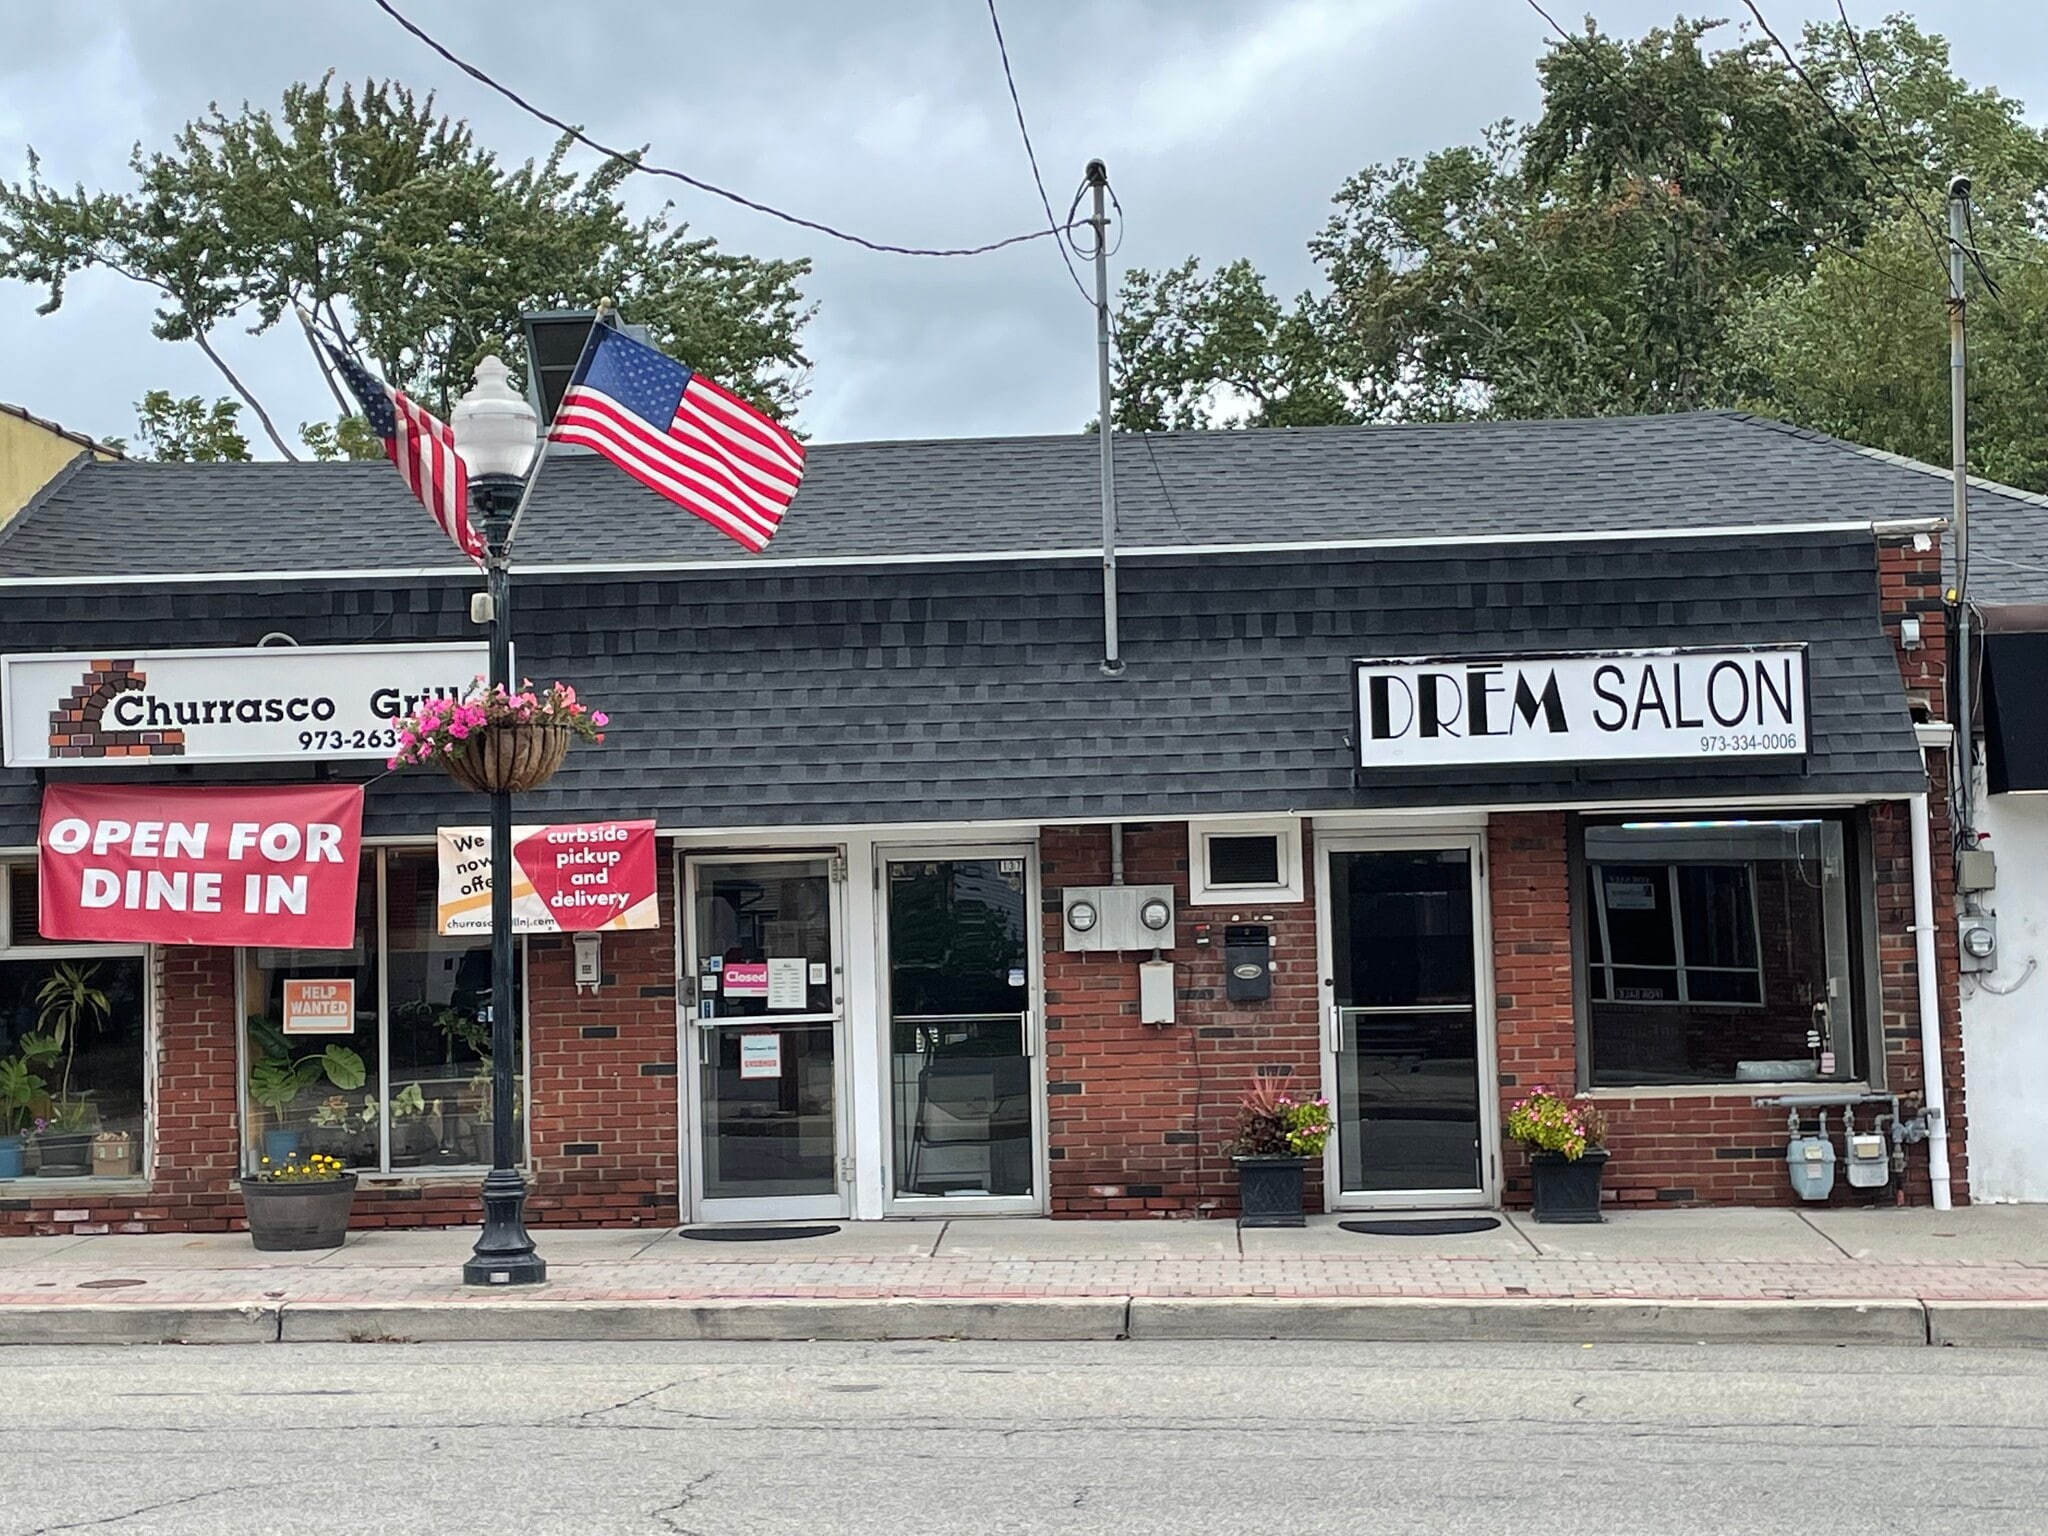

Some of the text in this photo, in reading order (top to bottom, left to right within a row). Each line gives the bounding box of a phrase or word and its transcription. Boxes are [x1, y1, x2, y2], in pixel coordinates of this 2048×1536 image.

[1592, 658, 1794, 732] SALON
[114, 695, 336, 727] Churrasco
[1700, 733, 1797, 752] 973-334-0006
[47, 817, 345, 864] OPEN FOR
[453, 835, 485, 853] We
[547, 826, 629, 844] curbside
[456, 857, 493, 876] now
[556, 847, 621, 868] pickup
[460, 875, 493, 896] offe
[571, 867, 609, 885] and
[79, 867, 309, 915] DINE IN
[550, 890, 630, 909] delivery
[726, 971, 768, 983] Closed
[302, 986, 337, 1000] HELP
[290, 1000, 348, 1015] WANTED
